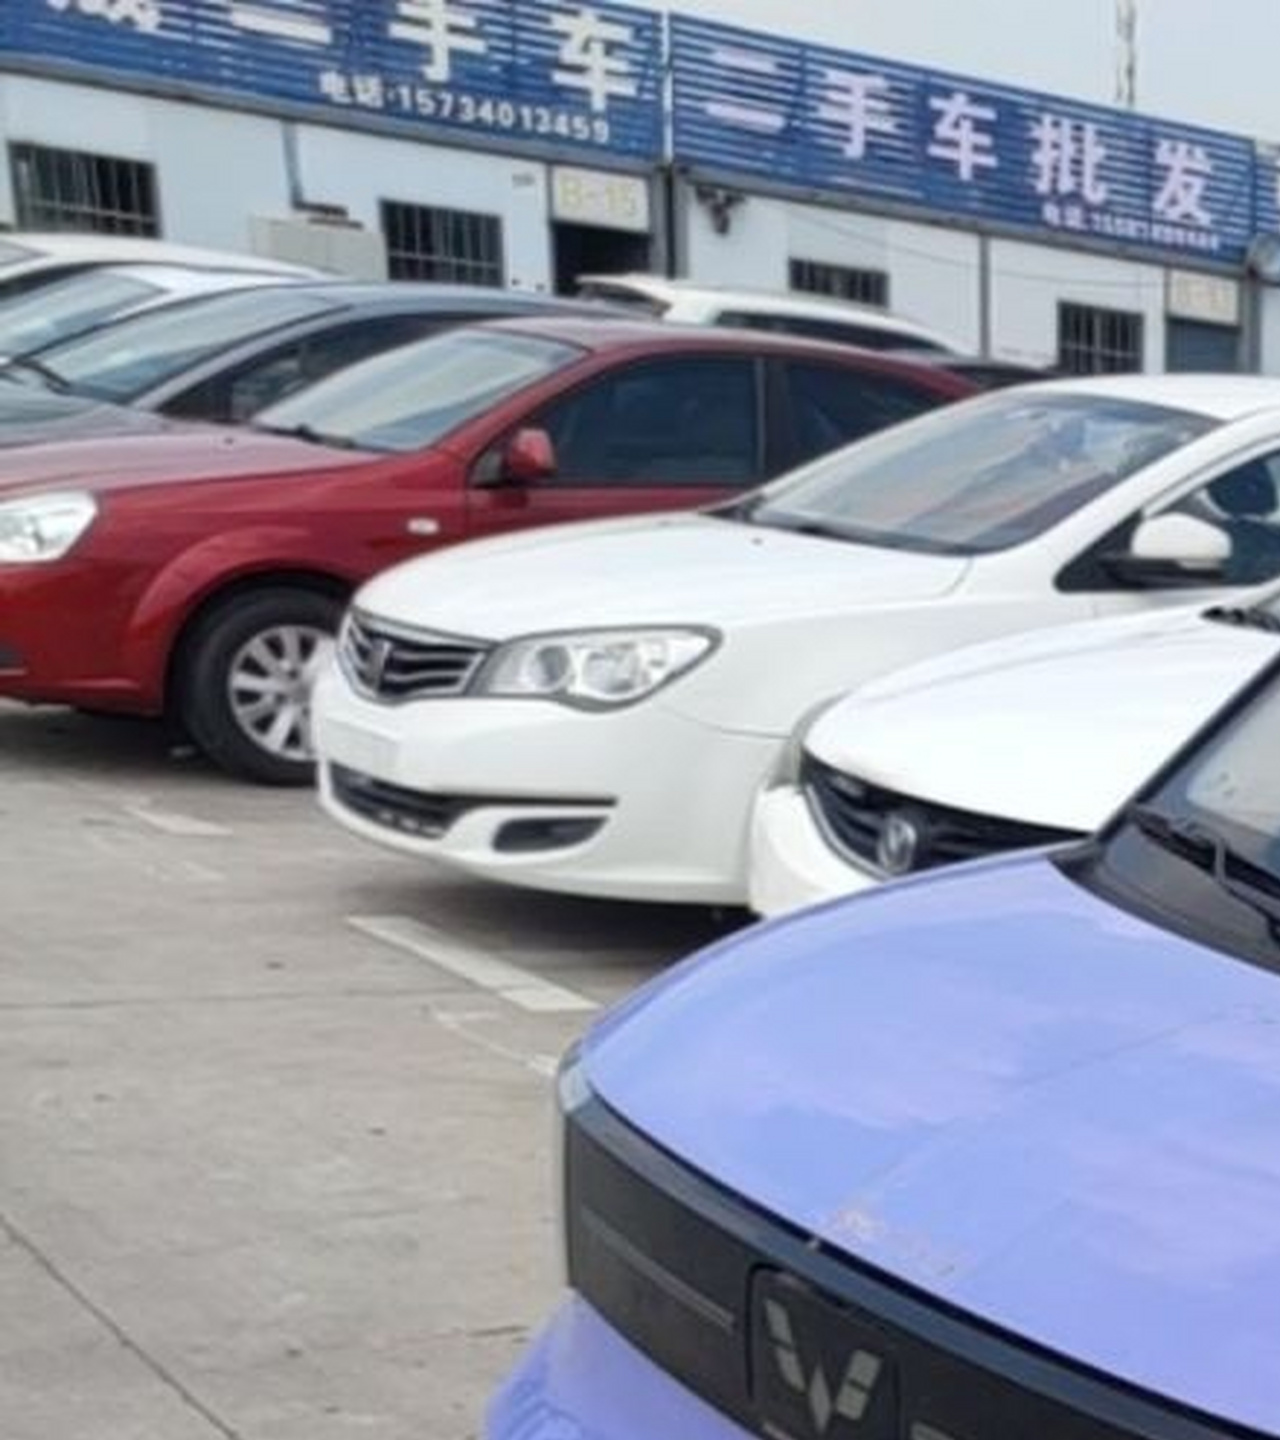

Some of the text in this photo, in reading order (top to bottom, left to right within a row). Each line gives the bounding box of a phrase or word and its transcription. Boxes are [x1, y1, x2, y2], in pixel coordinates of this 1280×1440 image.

[47, 0, 637, 110] 手车
[703, 47, 1212, 226] 二手车批发
